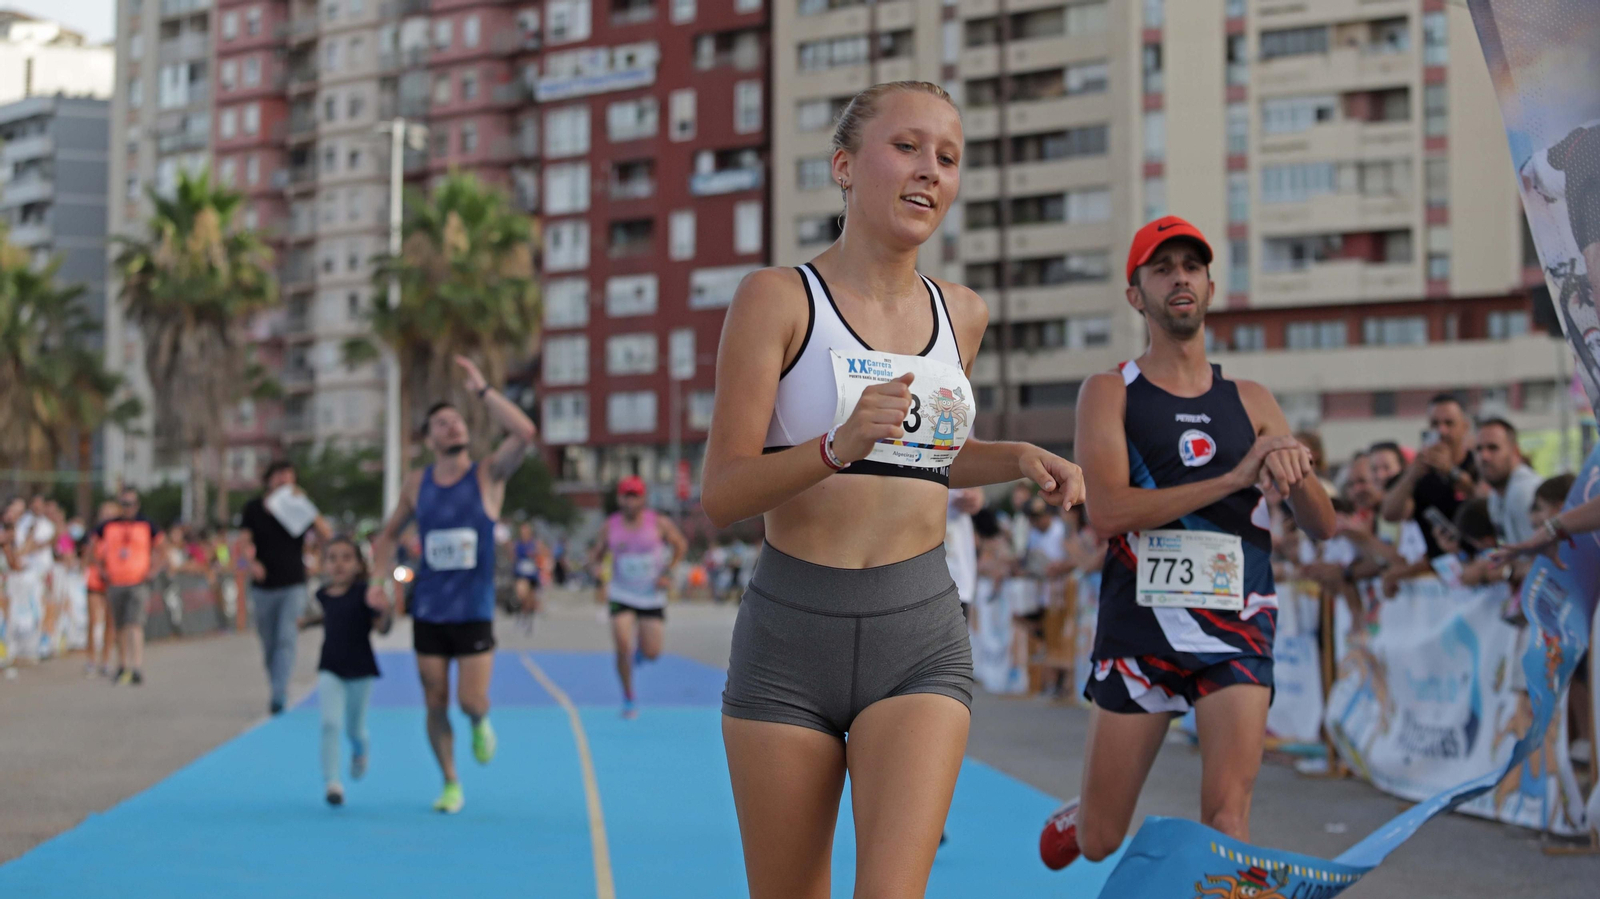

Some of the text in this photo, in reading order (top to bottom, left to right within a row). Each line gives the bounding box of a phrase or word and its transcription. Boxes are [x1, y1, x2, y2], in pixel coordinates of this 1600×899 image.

[846, 358, 868, 374] XX
[867, 359, 892, 369] Carrera
[868, 367, 894, 377] Popular
[892, 450, 915, 459] Algeciras
[1147, 557, 1195, 586] 773
